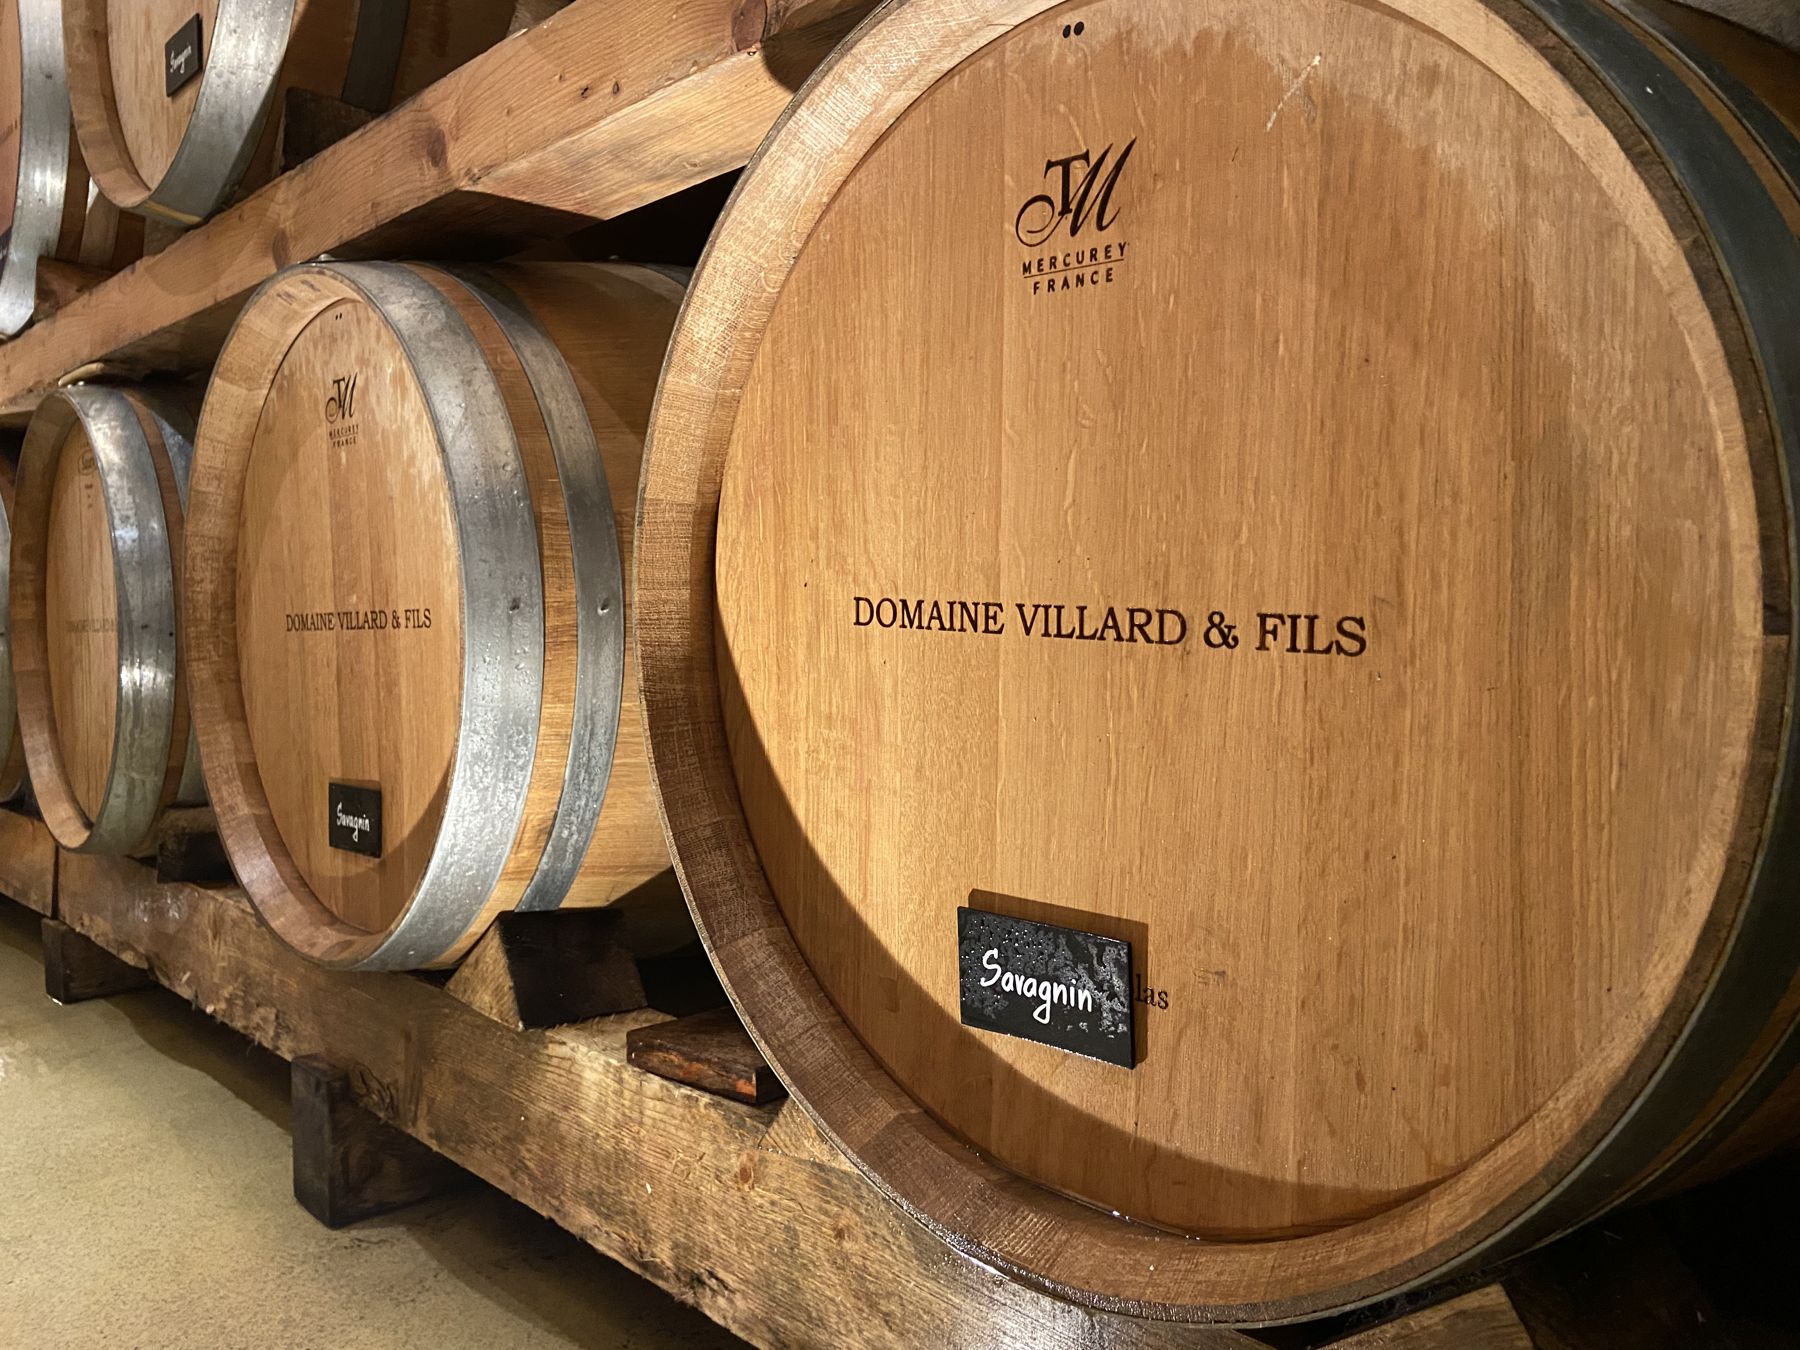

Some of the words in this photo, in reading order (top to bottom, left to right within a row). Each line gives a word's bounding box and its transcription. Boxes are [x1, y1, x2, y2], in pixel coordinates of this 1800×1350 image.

[1022, 241, 1127, 275] MERCUREY
[1033, 267, 1114, 295] FRANCE
[286, 612, 335, 632] DOMAINE
[338, 610, 388, 630] VILLARD
[391, 609, 401, 629] &
[404, 608, 432, 629] FILS
[853, 596, 1005, 635] DOMAINE
[1015, 603, 1188, 645] VILLARD
[1203, 610, 1240, 650] &
[1255, 612, 1367, 657] FILS
[336, 801, 370, 842] Savagnin
[979, 948, 1093, 1024] Savagnin
